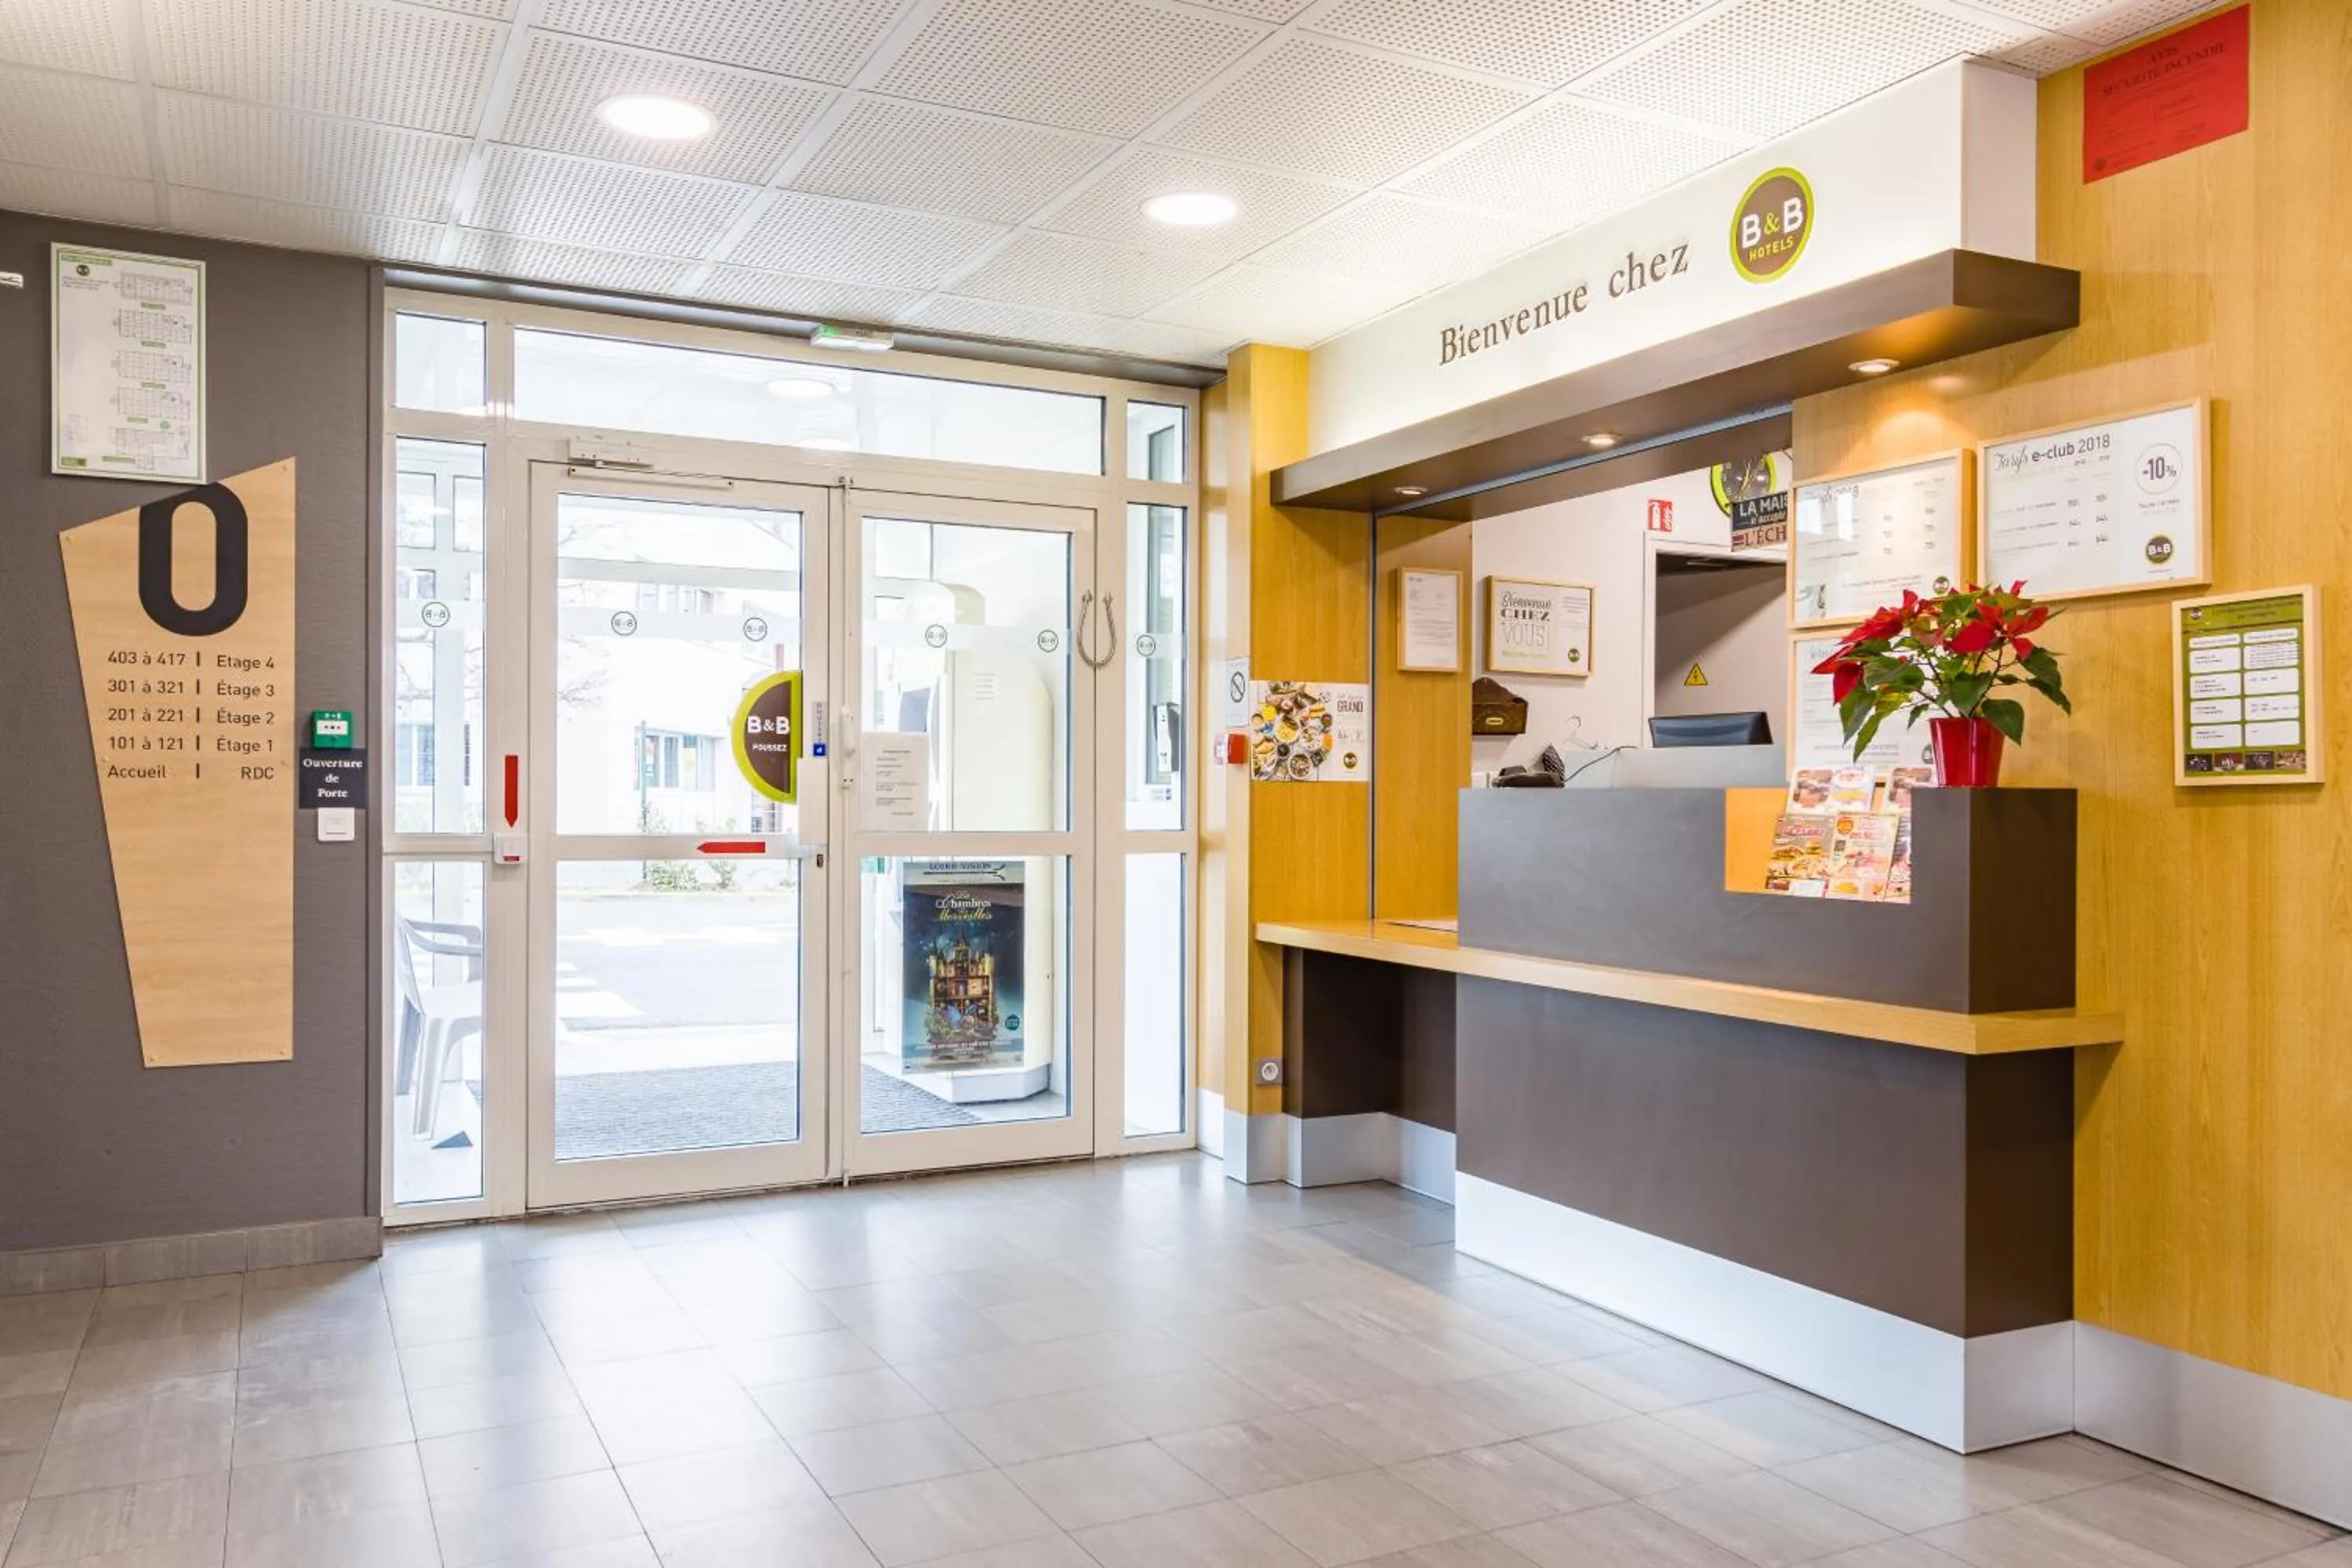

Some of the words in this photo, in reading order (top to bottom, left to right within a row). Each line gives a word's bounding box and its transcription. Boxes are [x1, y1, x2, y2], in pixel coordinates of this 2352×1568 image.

[1742, 197, 1803, 249] B&B
[1749, 236, 1795, 263] HOTELS
[1439, 282, 1589, 366] Bienvenue
[1608, 242, 1690, 299] chez
[2031, 441, 2074, 463] e-club
[2078, 434, 2110, 454] 2018
[1740, 501, 1757, 517] LA
[139, 481, 249, 637] 0
[1501, 608, 1549, 622] CHEZ
[107, 651, 137, 664] 403
[142, 652, 151, 665] à
[157, 653, 186, 666] 417
[266, 657, 274, 669] 4
[107, 680, 135, 693] 301
[142, 680, 151, 694] à
[157, 681, 183, 694] 321
[216, 679, 261, 699] Étage
[266, 684, 275, 697] 3
[107, 708, 135, 721] 201
[142, 708, 151, 722] à
[157, 709, 183, 722] 221
[216, 707, 261, 727] Étage
[266, 712, 275, 724] 2
[747, 715, 789, 735] B&B
[108, 736, 135, 750] 101
[142, 736, 151, 750] à
[158, 737, 183, 750] 121
[216, 735, 261, 754] Étage
[267, 739, 273, 752] 1
[752, 743, 788, 752] POUSSEZ
[107, 764, 167, 779] Accueil
[240, 766, 274, 779] RDC
[303, 758, 364, 768] Ouverture
[325, 773, 339, 783] de
[317, 788, 349, 798] Porte
